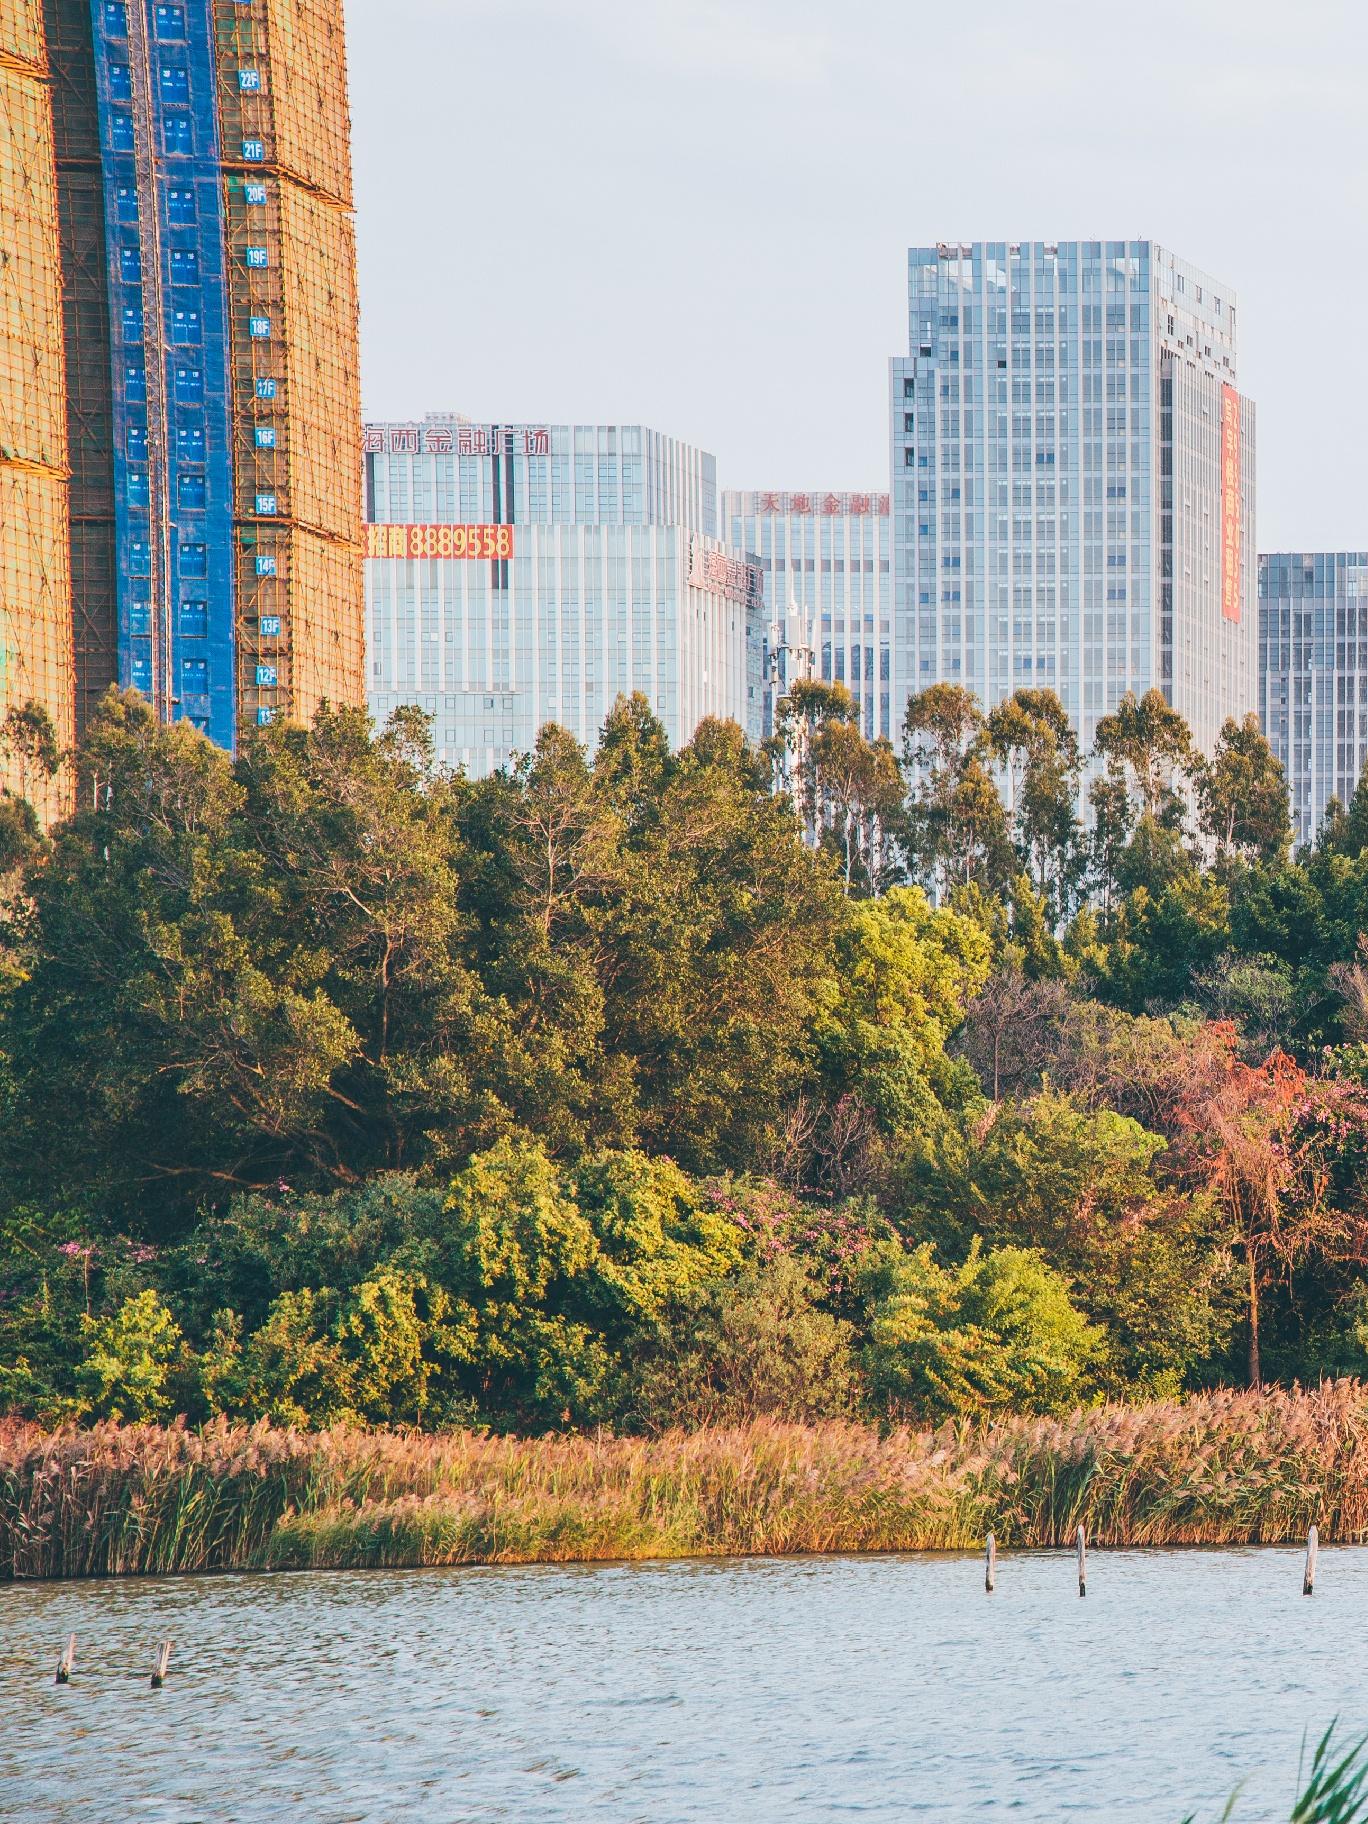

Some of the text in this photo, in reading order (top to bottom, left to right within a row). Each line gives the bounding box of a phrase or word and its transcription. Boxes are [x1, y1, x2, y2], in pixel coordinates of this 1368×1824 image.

[241, 72, 258, 87] 22F
[244, 143, 262, 158] 21F
[247, 186, 266, 202] 20F
[249, 249, 267, 265] 19F
[251, 320, 269, 335] 18F
[257, 430, 274, 445] 16F
[361, 427, 552, 455] 海西金融广场
[257, 497, 275, 512] 15F
[257, 558, 276, 573] 14F
[262, 619, 279, 634] 13F
[258, 668, 276, 683] 12F
